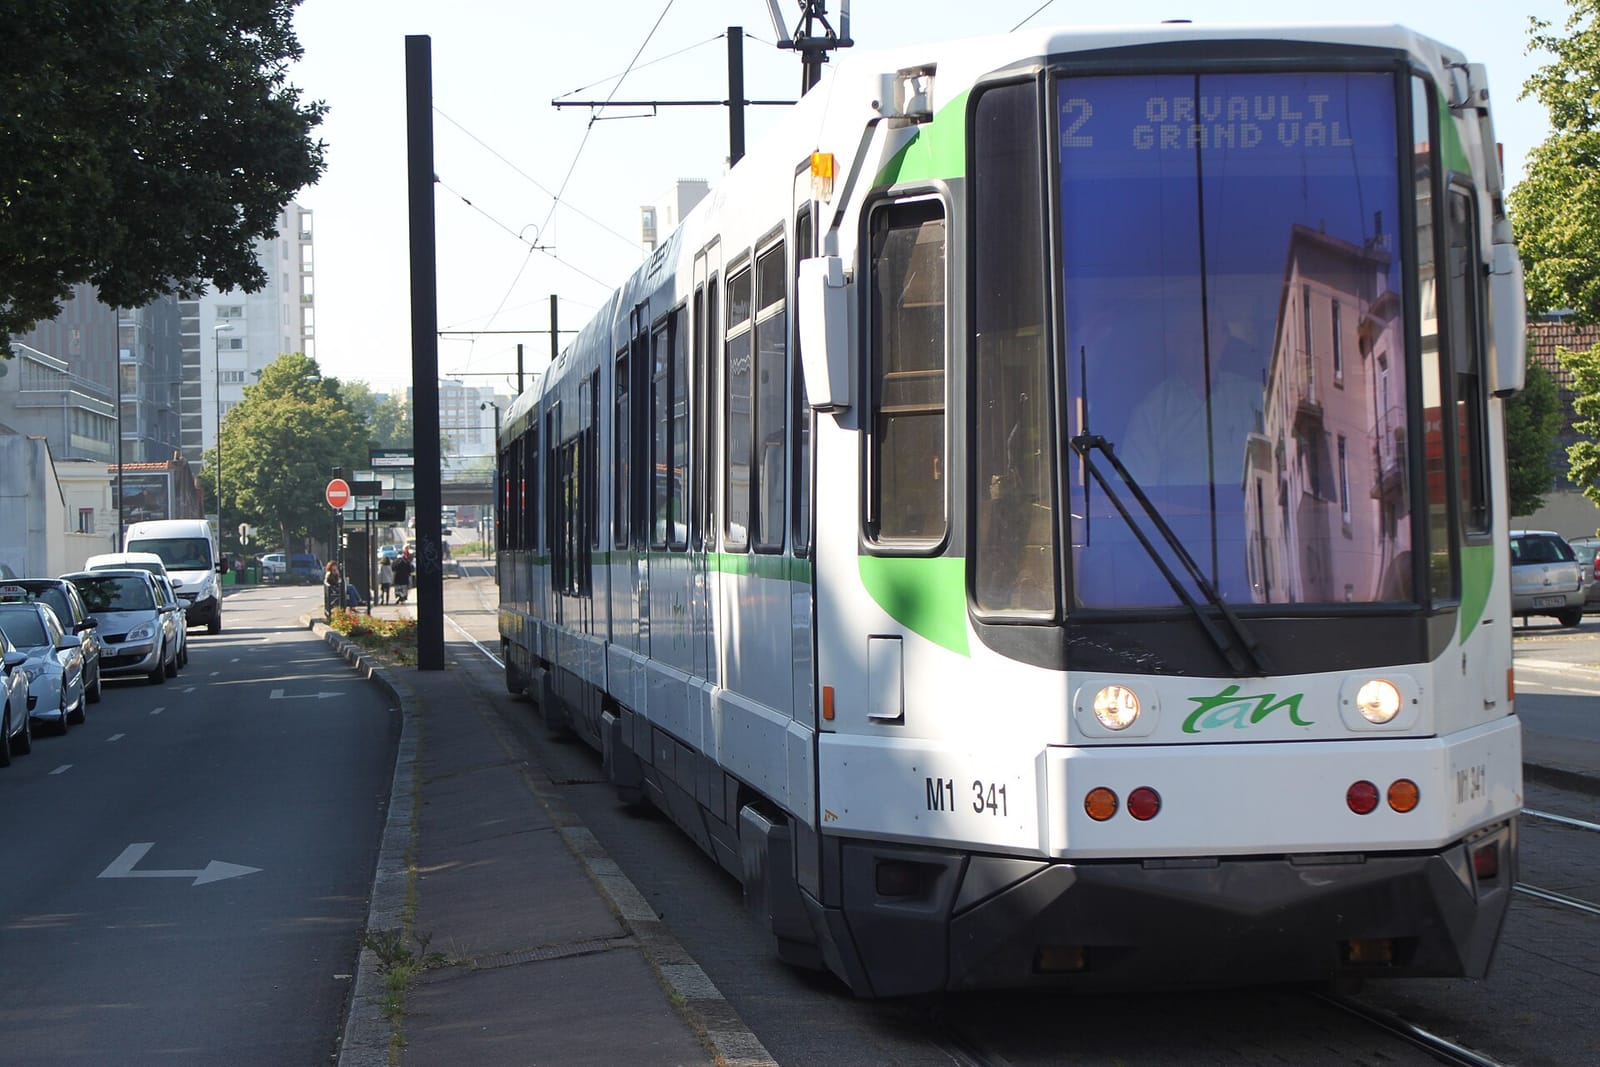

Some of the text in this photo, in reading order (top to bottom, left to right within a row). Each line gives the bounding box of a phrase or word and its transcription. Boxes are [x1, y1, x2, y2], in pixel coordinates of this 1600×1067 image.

[1062, 98, 1093, 147] 2
[1146, 95, 1329, 122] ORVAULT
[1133, 122, 1352, 149] GRAND VAL
[1182, 684, 1317, 734] tan
[926, 777, 1008, 817] M1 341
